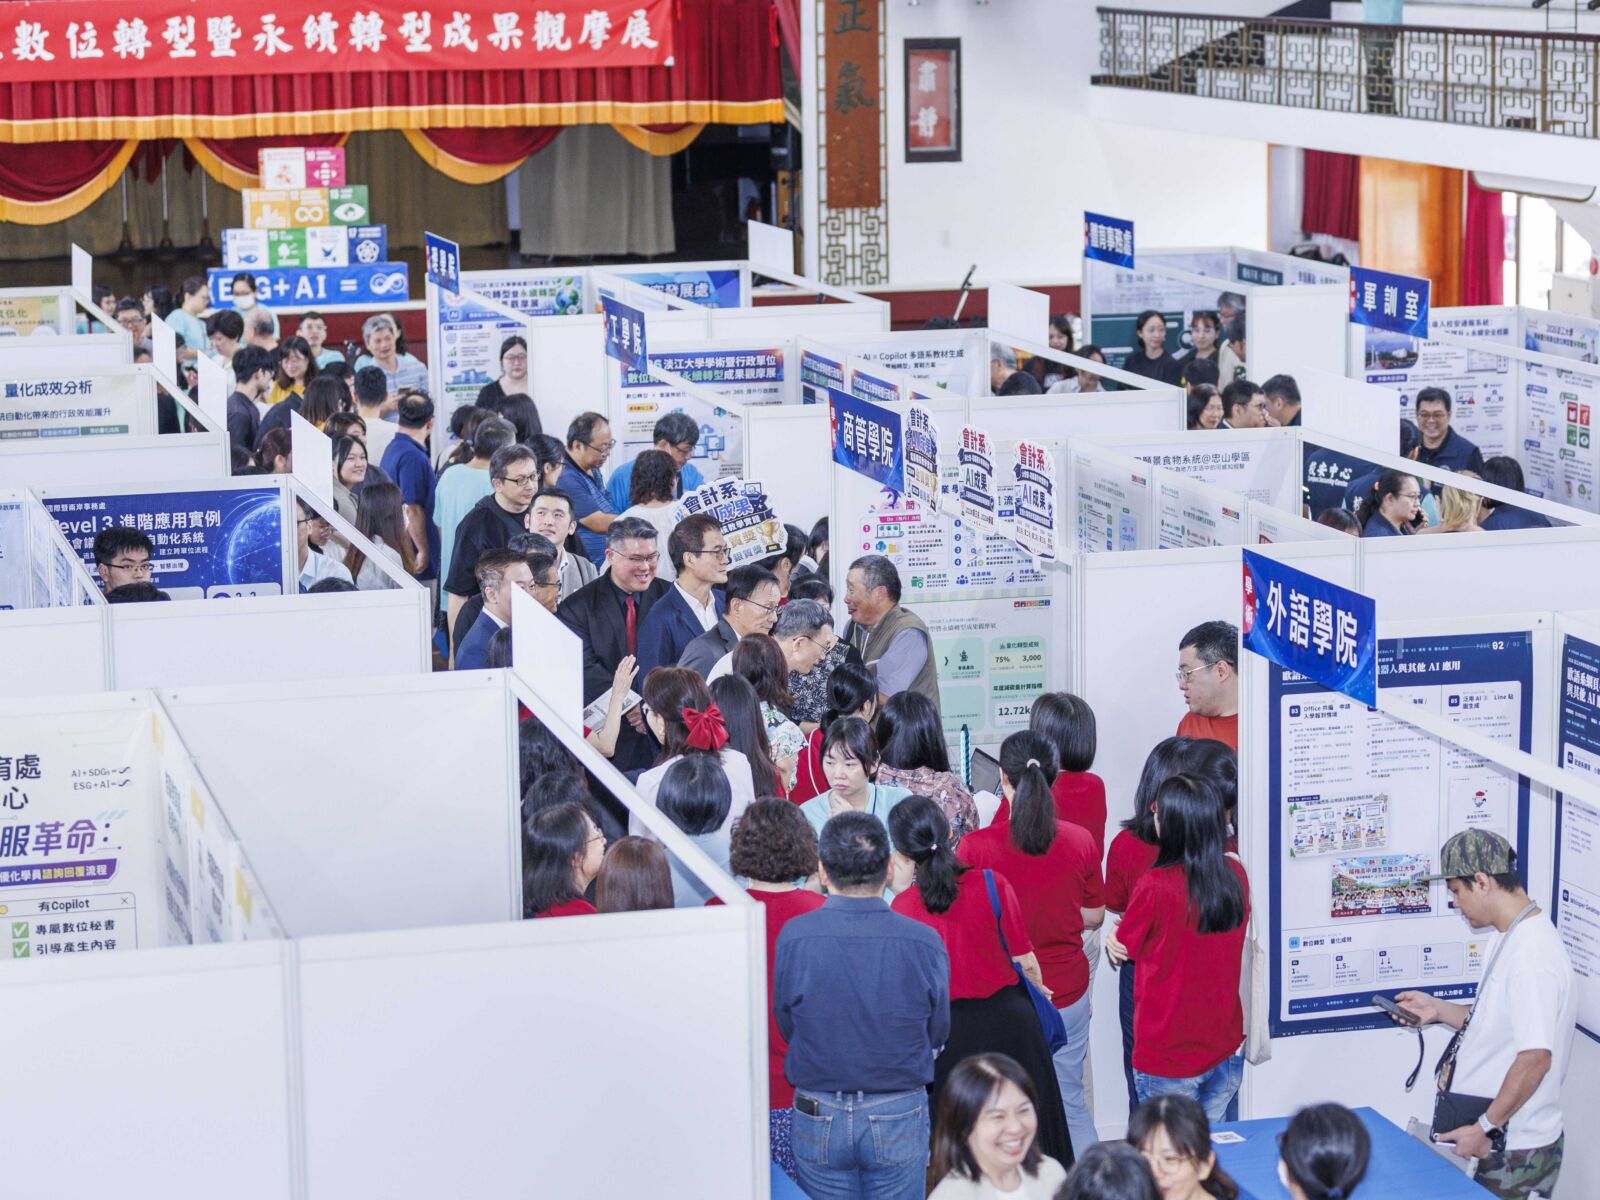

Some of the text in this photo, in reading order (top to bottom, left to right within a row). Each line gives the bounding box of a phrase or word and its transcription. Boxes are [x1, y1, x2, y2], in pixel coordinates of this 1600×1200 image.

[0, 8, 659, 62] 數位轉型暨永續轉型成果觀摩展
[218, 275, 327, 302] EG+AI
[1363, 281, 1420, 321] 軍訓室
[610, 314, 643, 356] 工學院
[879, 352, 908, 363] Copilot
[5, 380, 93, 398] 量化成效分析
[842, 410, 894, 468] 商管學院
[962, 427, 987, 454] 會計系
[1019, 442, 1045, 471] 會計系
[1133, 452, 1250, 466] 願景食物系統@忠山學區
[683, 481, 739, 515] 會計系
[120, 510, 221, 535] 進階應用實例
[1266, 580, 1359, 669] 外語學院
[1492, 641, 1505, 650] 02
[1022, 654, 1042, 662] 3,000
[1428, 662, 1440, 672] AI
[1442, 660, 1461, 671] 應用
[998, 705, 1031, 716] 12.72k
[3, 786, 29, 810] 心
[38, 899, 90, 912] 有Copilot
[35, 919, 115, 936] 專屬數位秘書
[36, 939, 117, 956] 引導產生內容
[1335, 962, 1347, 970] 1.5
